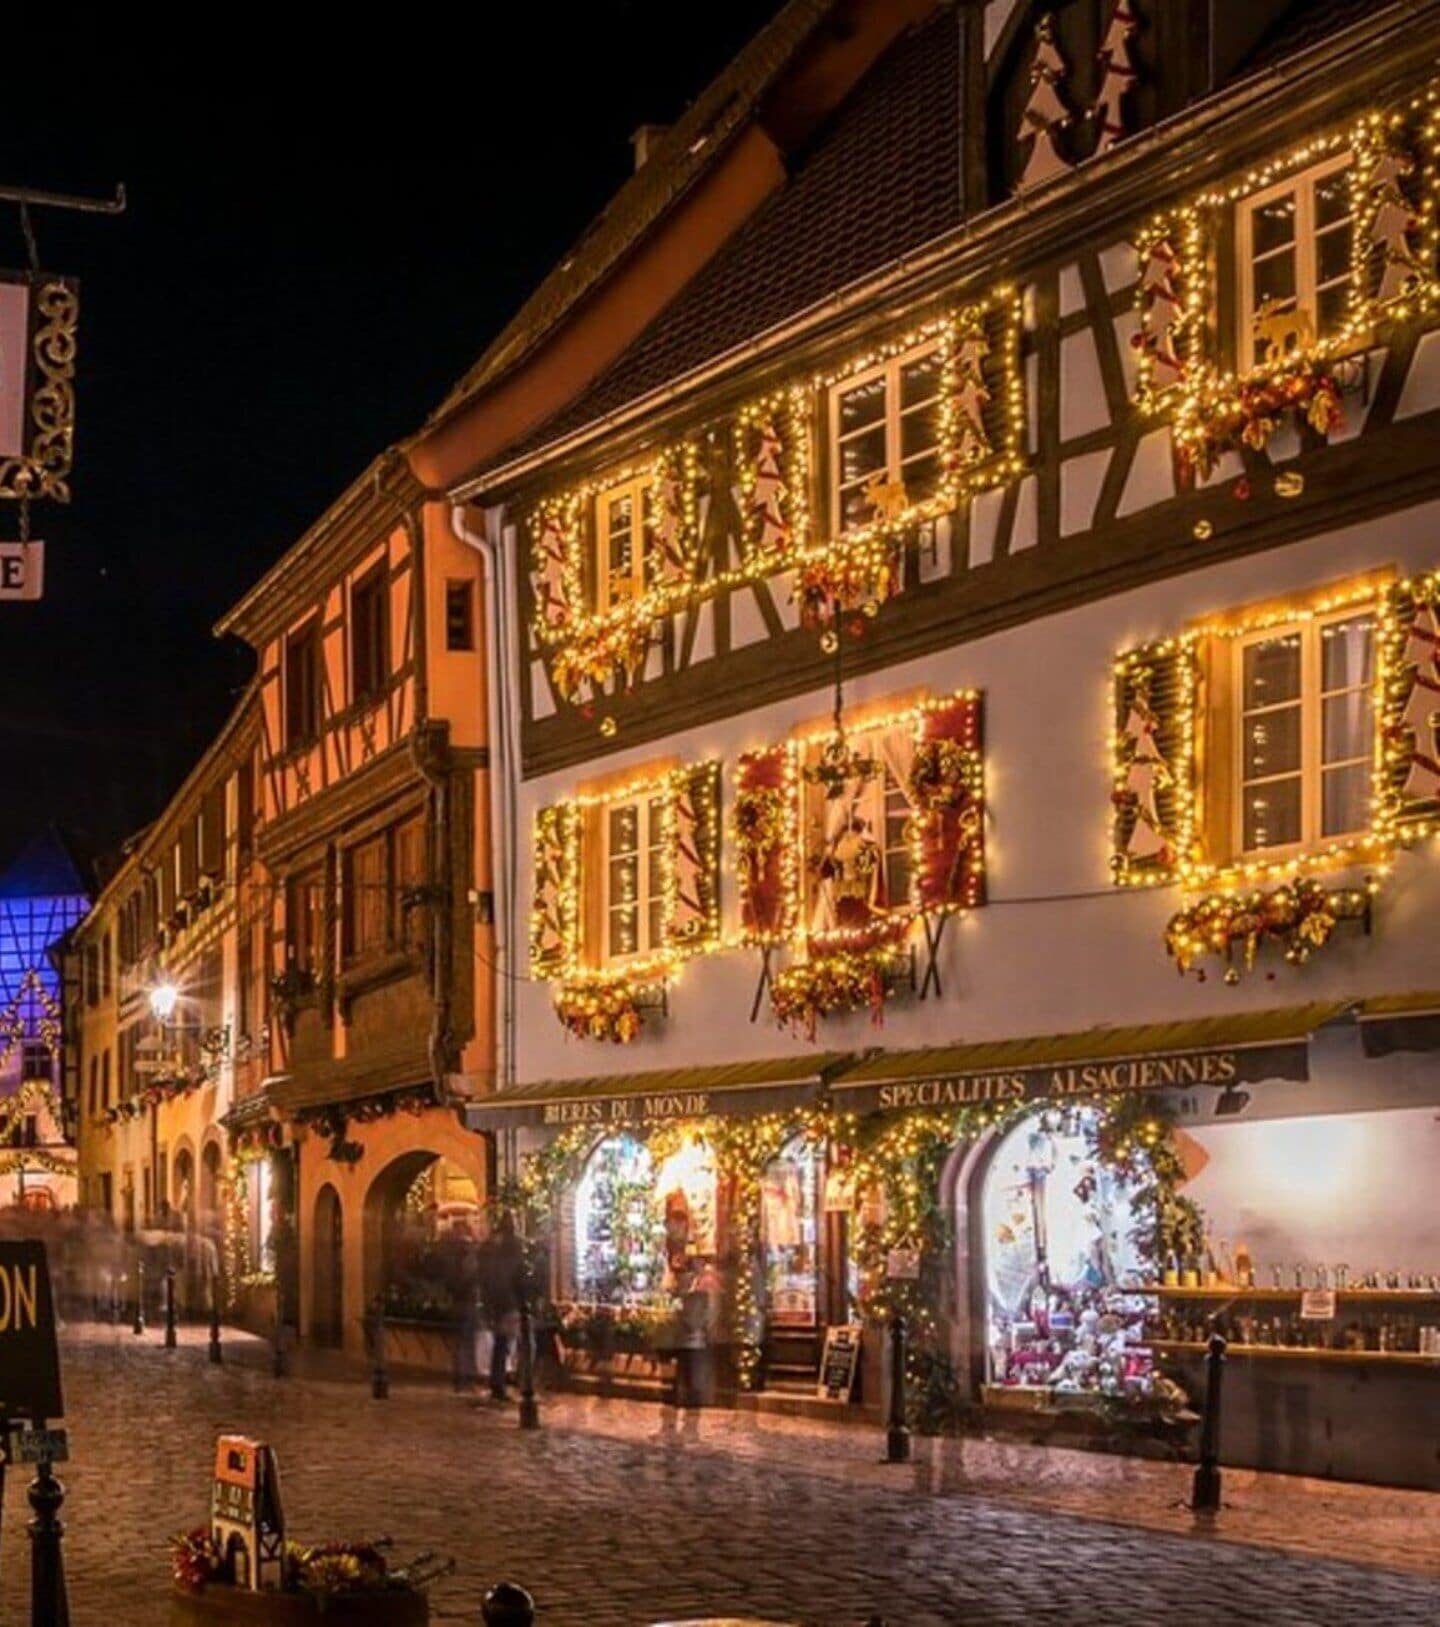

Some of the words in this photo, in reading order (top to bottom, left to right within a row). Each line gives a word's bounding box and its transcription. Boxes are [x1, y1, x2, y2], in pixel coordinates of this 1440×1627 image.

[1048, 1055, 1236, 1094] ALSACIENNES
[611, 1099, 633, 1119] DU
[643, 1095, 709, 1117] MONDE
